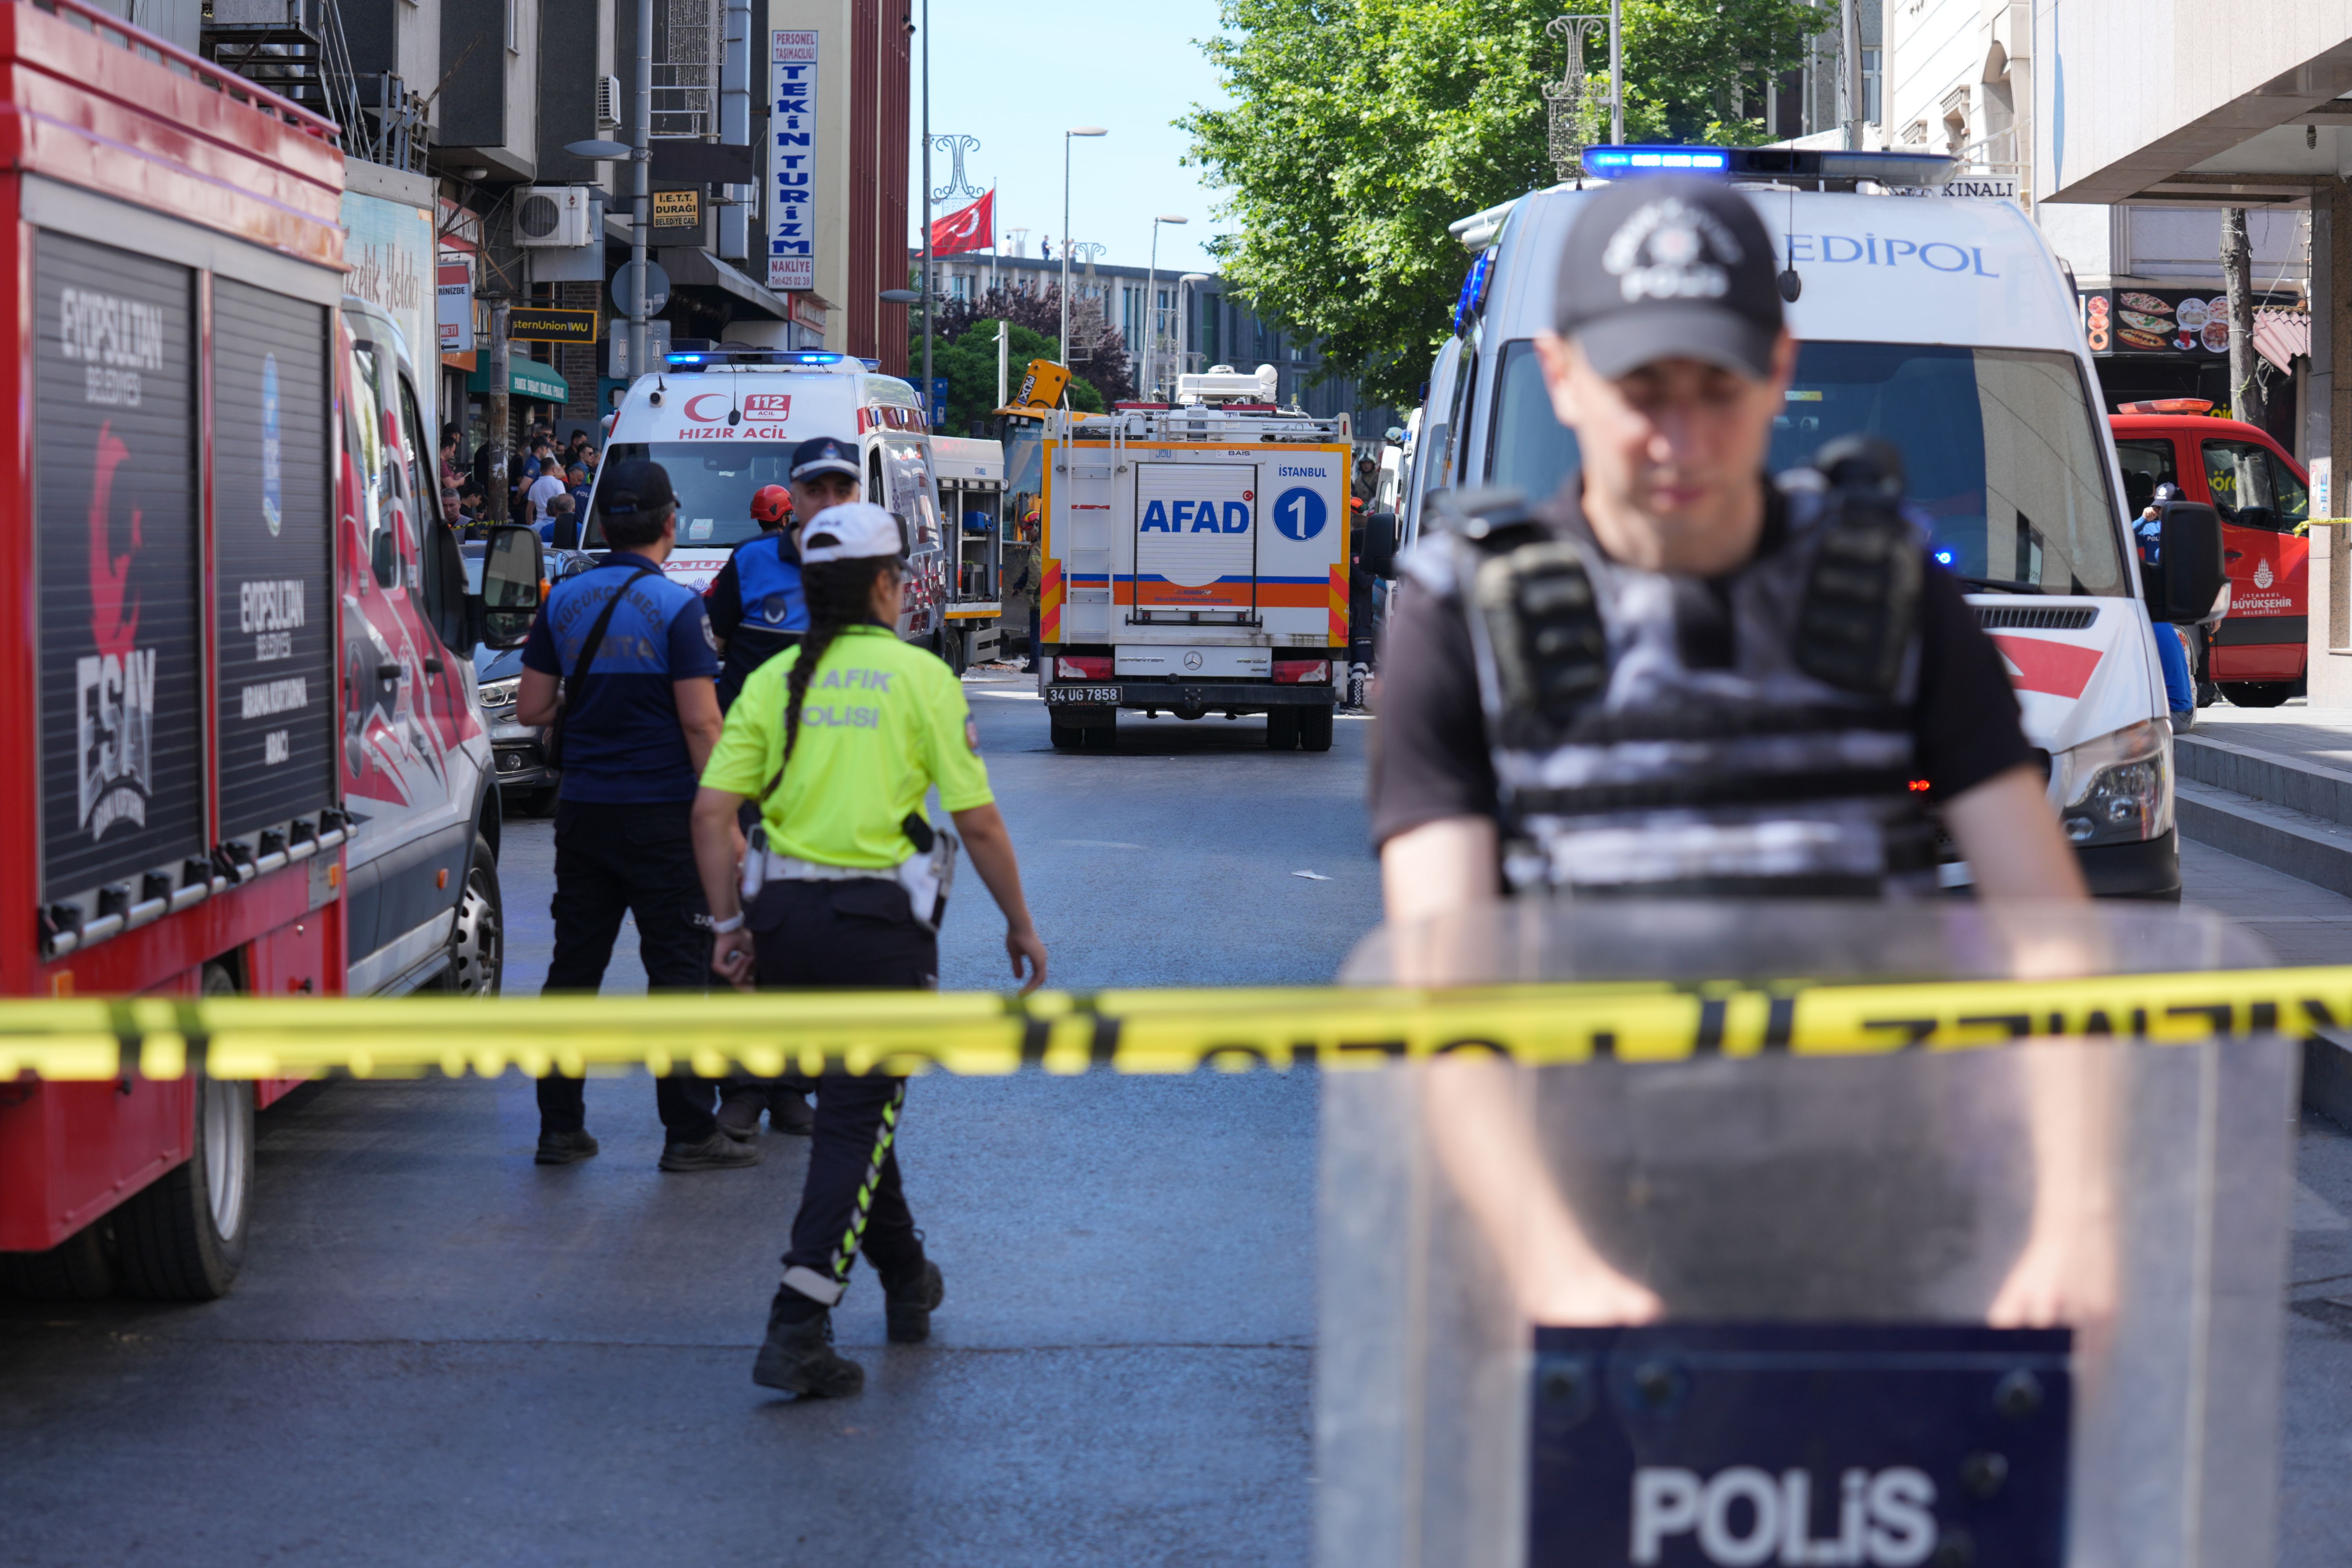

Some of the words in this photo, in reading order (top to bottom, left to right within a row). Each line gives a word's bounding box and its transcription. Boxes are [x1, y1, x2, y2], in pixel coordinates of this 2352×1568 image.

[777, 34, 815, 45] PERSONEL
[1942, 183, 2013, 196] KINALI
[660, 193, 692, 202] İ.E.T.T.
[656, 203, 696, 213] DURAĞI
[1774, 234, 2000, 278] EDİPOL
[771, 258, 810, 272] NAKLİYE
[794, 277, 801, 285] 02
[802, 277, 810, 285] 39
[1020, 375, 1035, 399] 3CX
[752, 396, 784, 408] 112
[679, 428, 734, 439] HIZIR
[742, 425, 787, 439] ACİL
[1279, 464, 1327, 477] İSTANBUL
[1140, 500, 1250, 533] AFAD
[1288, 496, 1306, 538] 1
[2232, 596, 2292, 610] BÜYÜKŞEHİR
[1051, 690, 1065, 701] 34
[1069, 689, 1083, 701] UG
[1087, 688, 1117, 701] 7858
